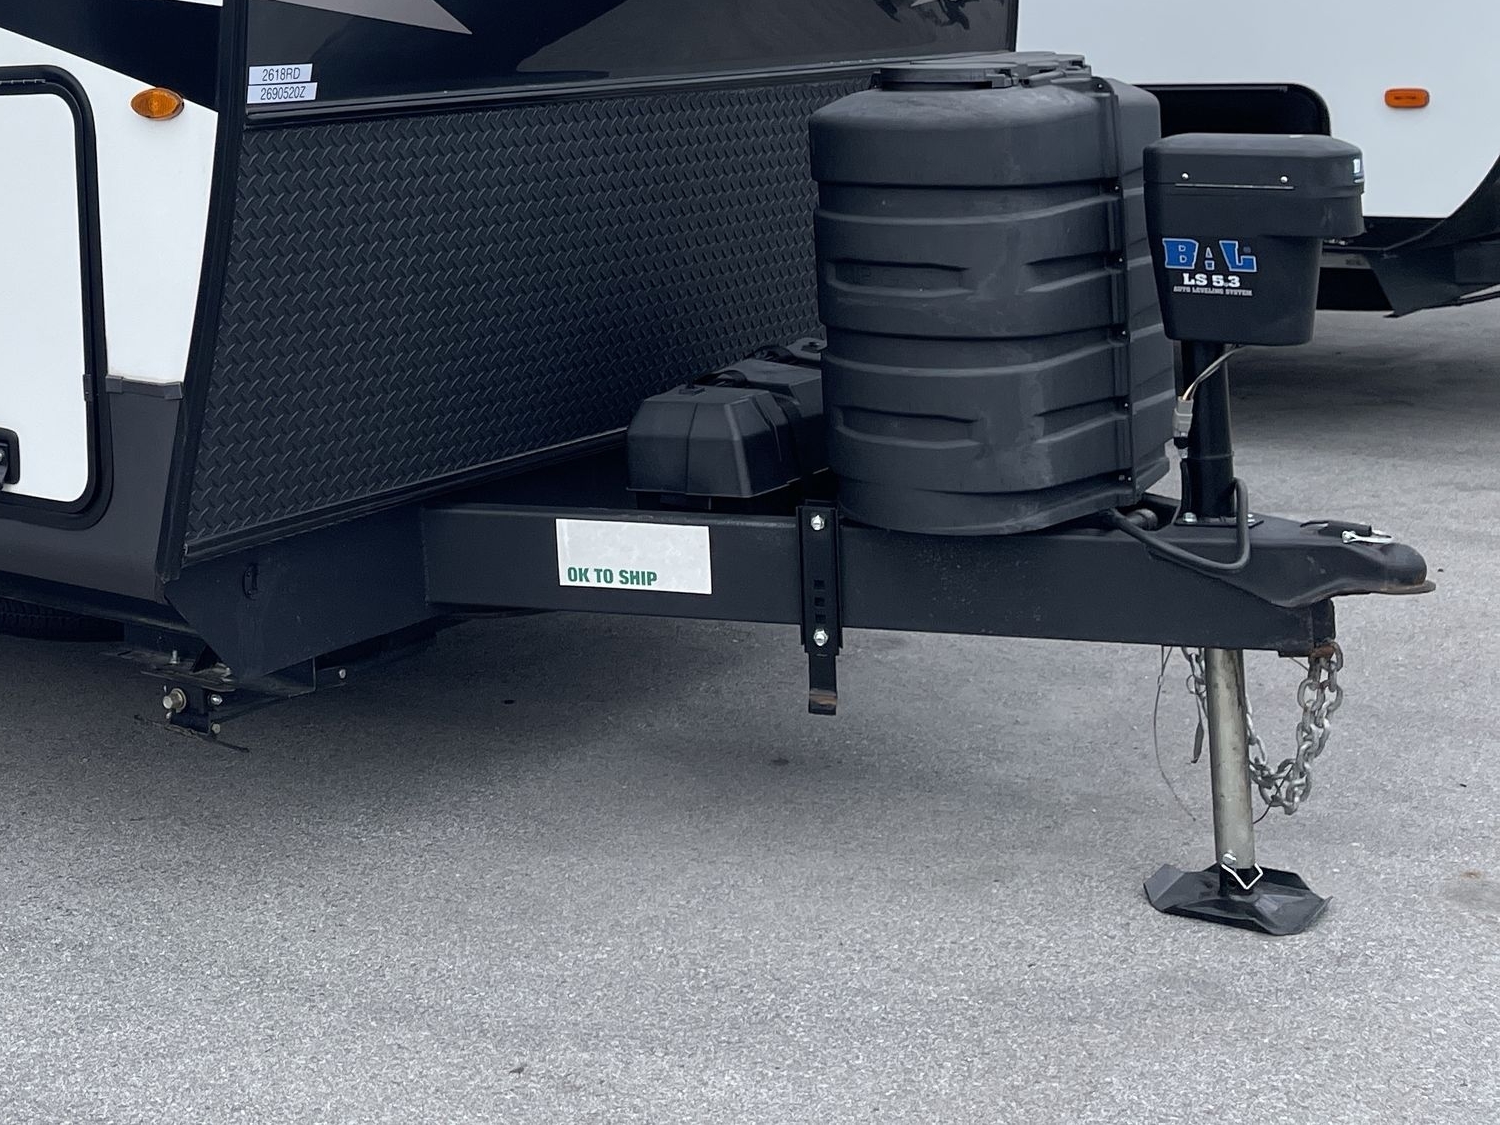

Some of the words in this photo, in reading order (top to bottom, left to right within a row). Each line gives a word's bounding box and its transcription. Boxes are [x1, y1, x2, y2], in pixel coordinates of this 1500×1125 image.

[262, 67, 301, 82] 2618RD
[1162, 238, 1257, 273] BAL
[1183, 272, 1208, 286] LS
[1211, 274, 1241, 288] 5.3
[1173, 285, 1191, 293] AUTO
[1192, 286, 1224, 295] LEVELING
[1225, 288, 1253, 296] SYSTEM
[567, 566, 590, 582] OK
[593, 568, 614, 584] TO
[619, 569, 658, 586] SHIP
